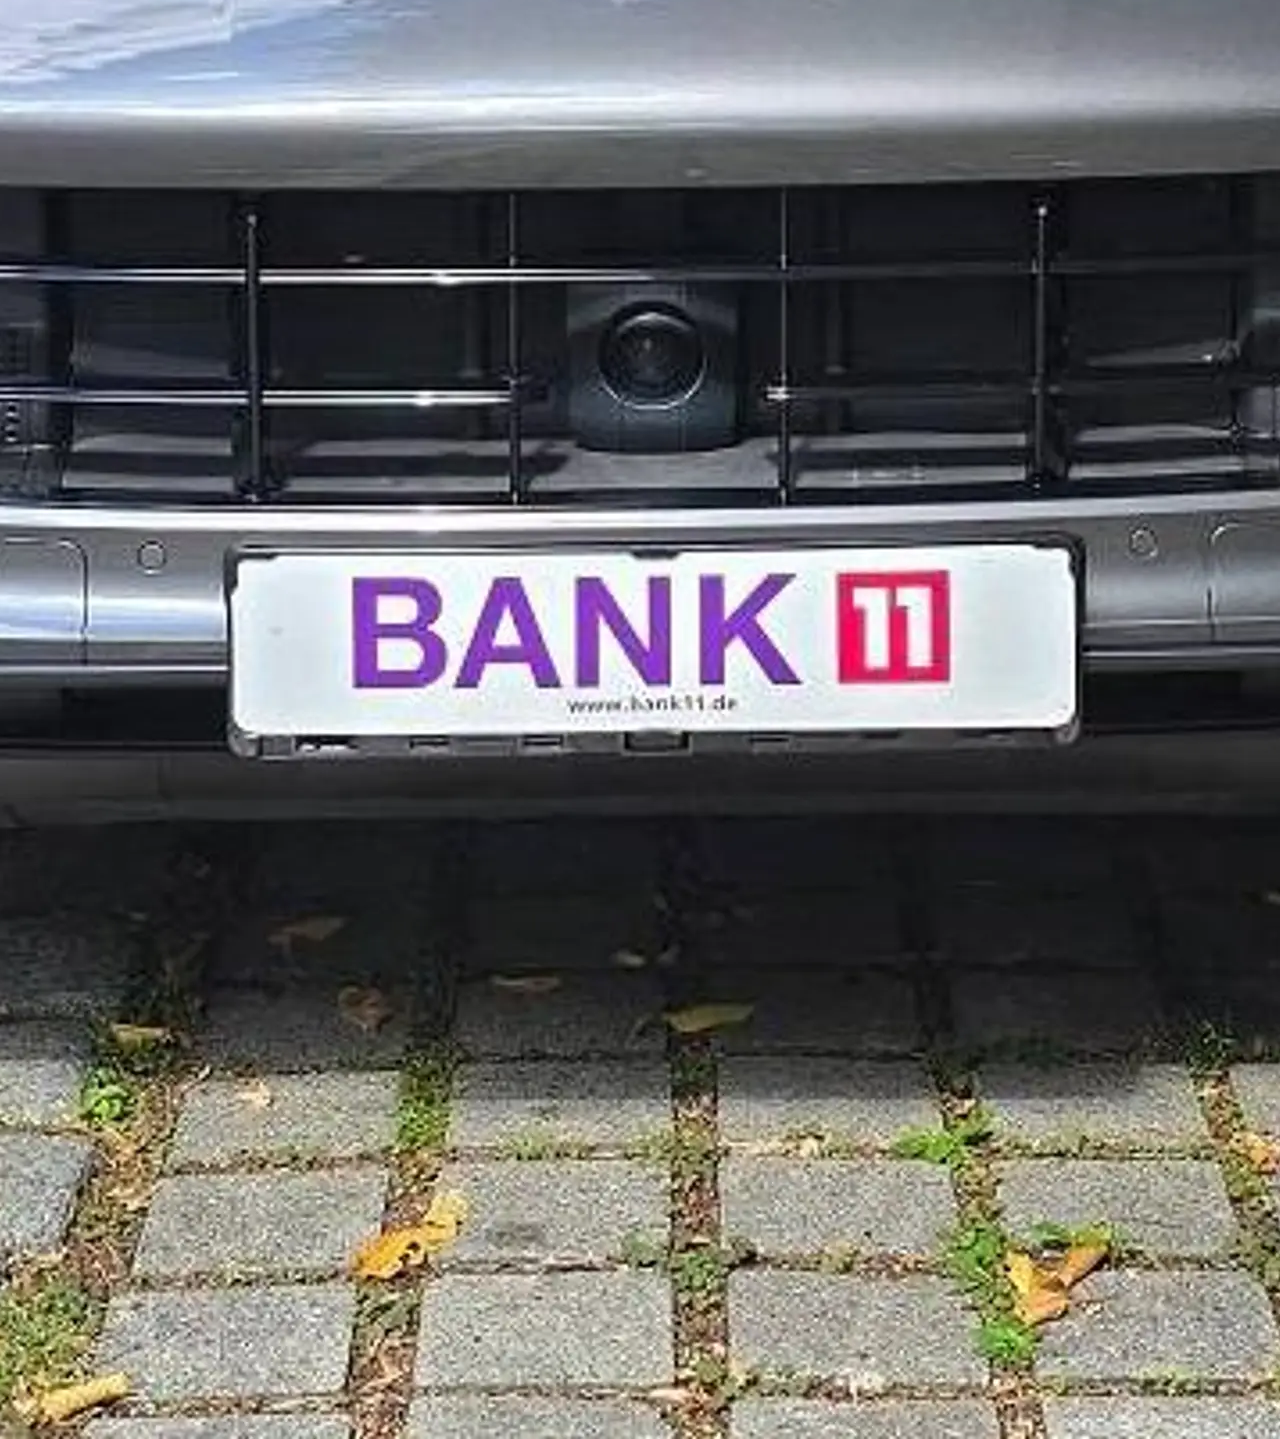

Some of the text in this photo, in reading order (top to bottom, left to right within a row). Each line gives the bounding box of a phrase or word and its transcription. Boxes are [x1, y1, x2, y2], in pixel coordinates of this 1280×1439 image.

[352, 573, 936, 689] BANK 11
[566, 694, 738, 713] www.bank11.de
